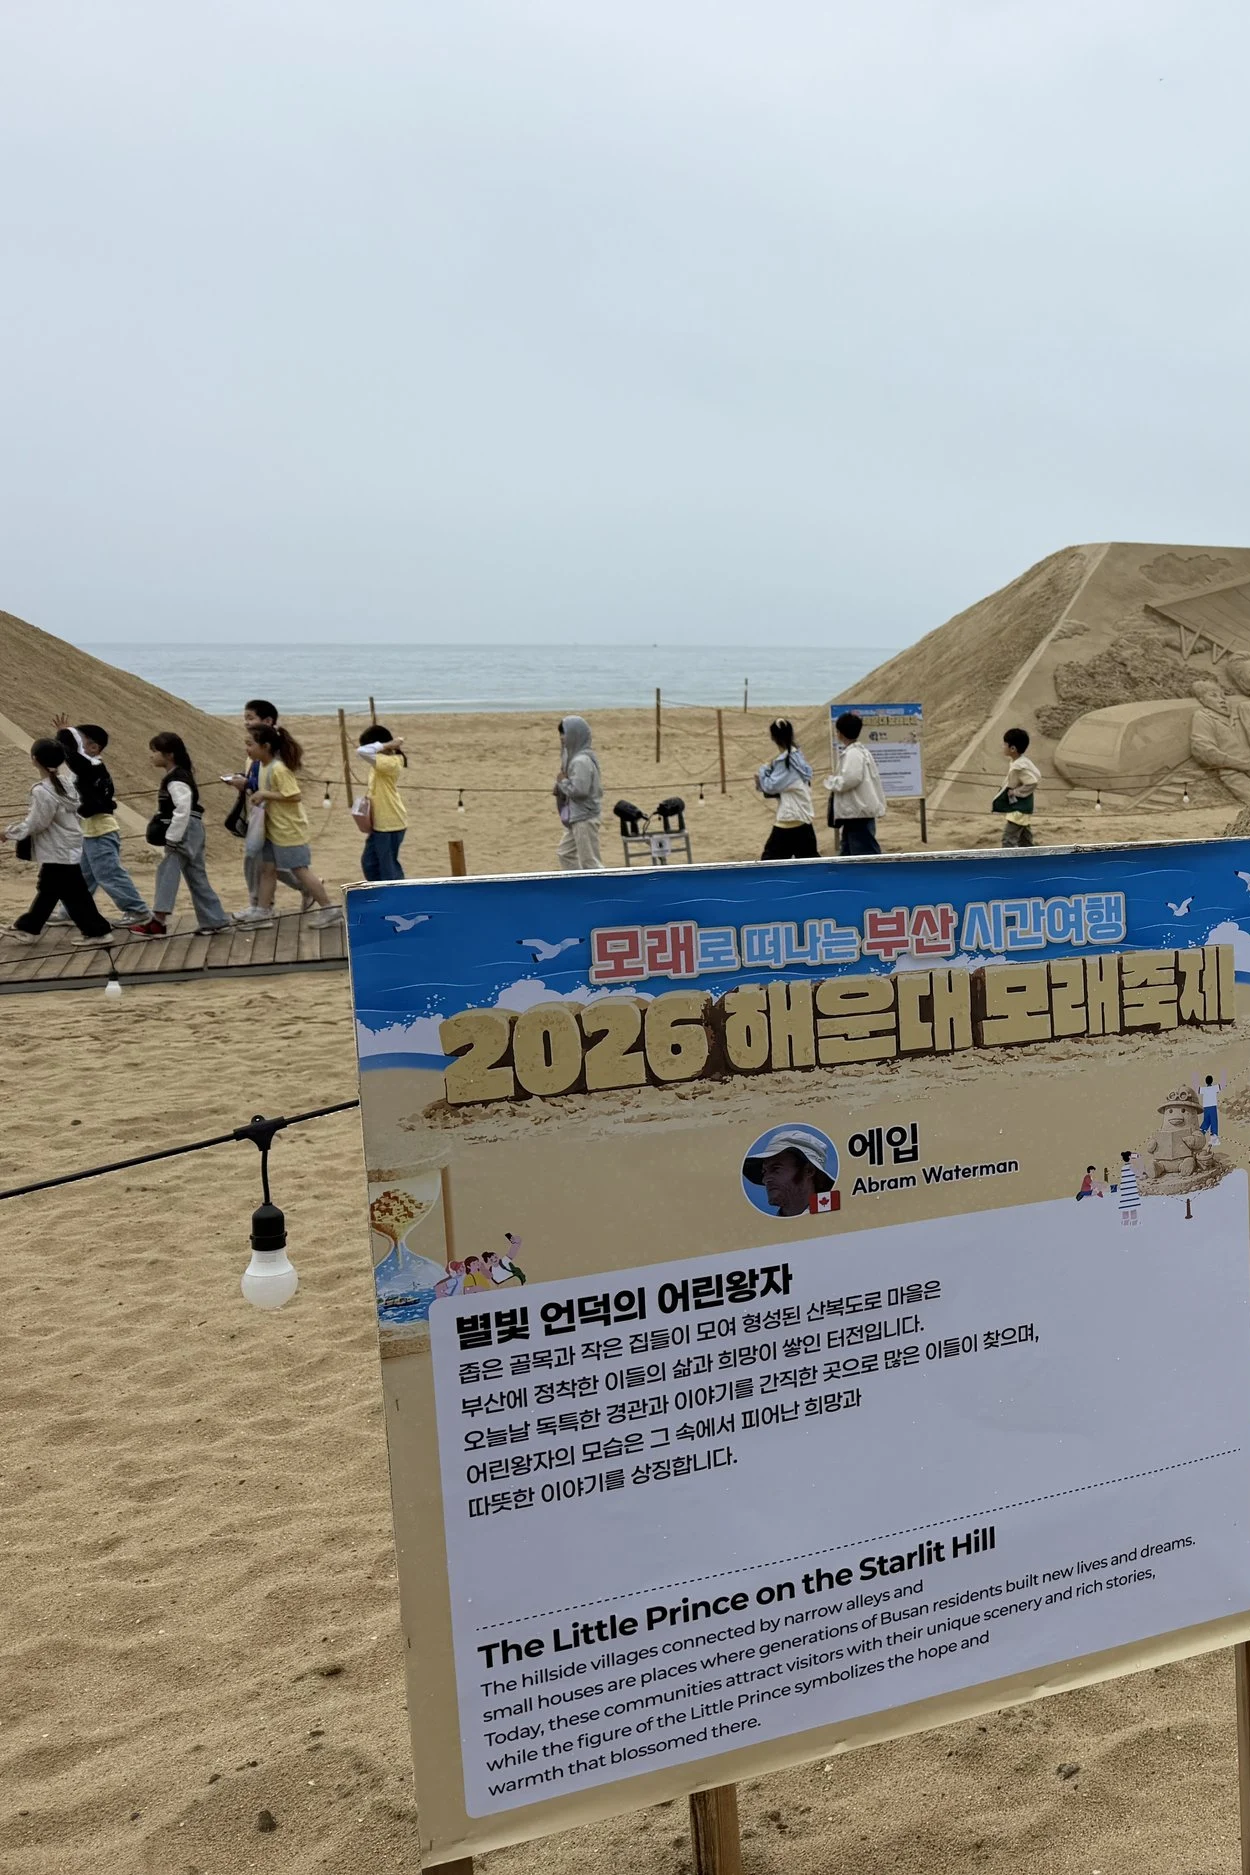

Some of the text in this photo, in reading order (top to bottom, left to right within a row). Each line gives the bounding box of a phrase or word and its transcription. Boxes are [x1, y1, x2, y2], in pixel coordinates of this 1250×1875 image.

[591, 892, 1126, 984] 모래로 떠나는 부산 시간여행
[439, 944, 1237, 1104] 2026 해운대 모래축제
[848, 1122, 920, 1168] 에입
[851, 1157, 1020, 1196] Abram Waterman
[455, 1262, 793, 1351] 별빛 언덕의 어린왕자
[458, 1280, 942, 1385] 좁은 골목과 작은 집들이 모여 형성된 산복도로 마을은
[461, 1314, 925, 1418] 부산에 정착한 이들의 삶과 희망이 쌓인 터전입니다.
[463, 1322, 1039, 1452] 오늘날 독특한 경관과 이야기를 간직한 곳으로 많은 이들이 찾으며,
[466, 1387, 862, 1485] 어린왕자의 모습은 그 속에서 피어난 희망과
[468, 1445, 738, 1518] 따뜻한 이야기를 상징합니다.
[476, 1525, 996, 1669] The Little Prince on the Starlit Hill
[479, 1578, 923, 1697] The hillside villages connected by narrow alleys and
[482, 1536, 1196, 1723] small houses are places where generations of Busan residents built new lives and dreams.
[483, 1568, 1156, 1747] Today, these communities attract visitors with their unique scenery and rich stories,
[486, 1629, 990, 1772] while the figure of the Little Prince symbolizes the hope and
[488, 1717, 761, 1797] warmth that blossomed there.
